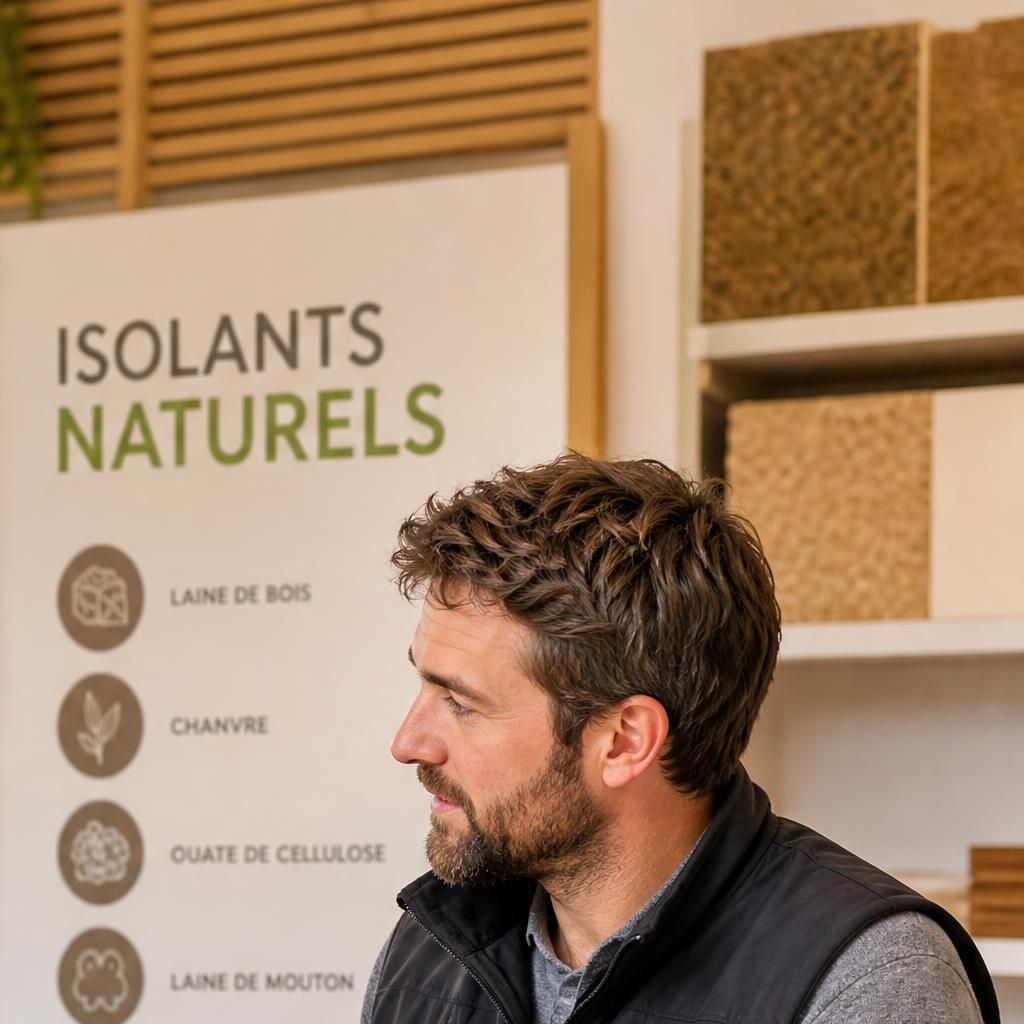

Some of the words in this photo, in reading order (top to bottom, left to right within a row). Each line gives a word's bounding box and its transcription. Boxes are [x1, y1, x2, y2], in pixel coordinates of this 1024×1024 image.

[57, 302, 385, 385] ISOLANTS
[57, 383, 446, 473] NATURELS
[170, 587, 228, 607] LAINE
[234, 586, 259, 605] DE
[266, 583, 313, 603] BOIS
[170, 716, 269, 736] CHANVRE
[170, 846, 238, 864] OUATE
[244, 846, 270, 864] DE
[275, 844, 386, 864] CELLULOSE
[170, 973, 228, 992] LAINE
[233, 973, 259, 992] DE
[264, 973, 355, 992] MOUTON
